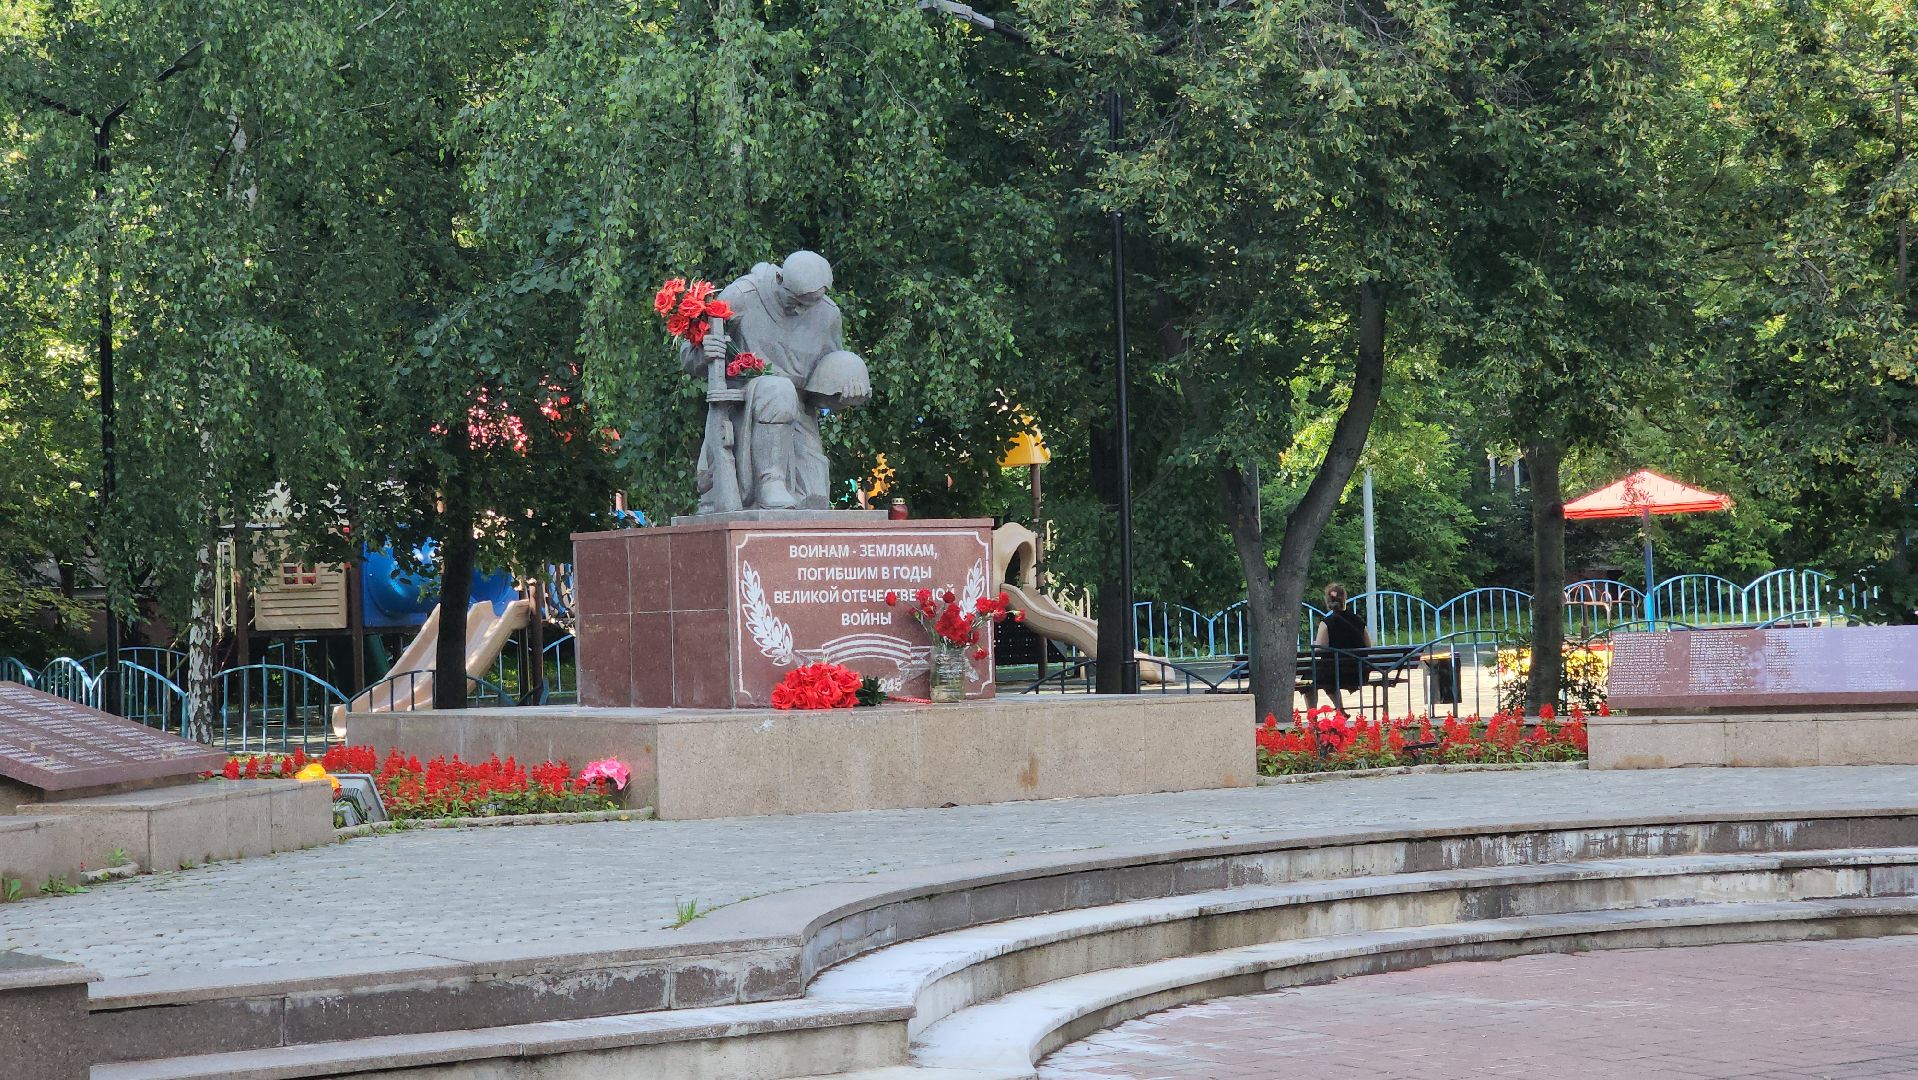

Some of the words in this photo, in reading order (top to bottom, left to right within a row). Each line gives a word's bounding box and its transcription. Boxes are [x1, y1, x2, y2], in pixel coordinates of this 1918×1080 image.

[789, 544, 849, 558] ВОИНАМ
[859, 543, 938, 560] ЗЕМЛЯКАМ,
[797, 566, 878, 581] ПОГИБШИМ
[881, 566, 890, 580] В
[893, 565, 932, 583] ГОДЫ
[774, 585, 839, 604] ВЕЛИКОЙ
[841, 584, 956, 603] ОТЕЧЕТВЕО
[841, 608, 892, 626] ВОЙНЫ
